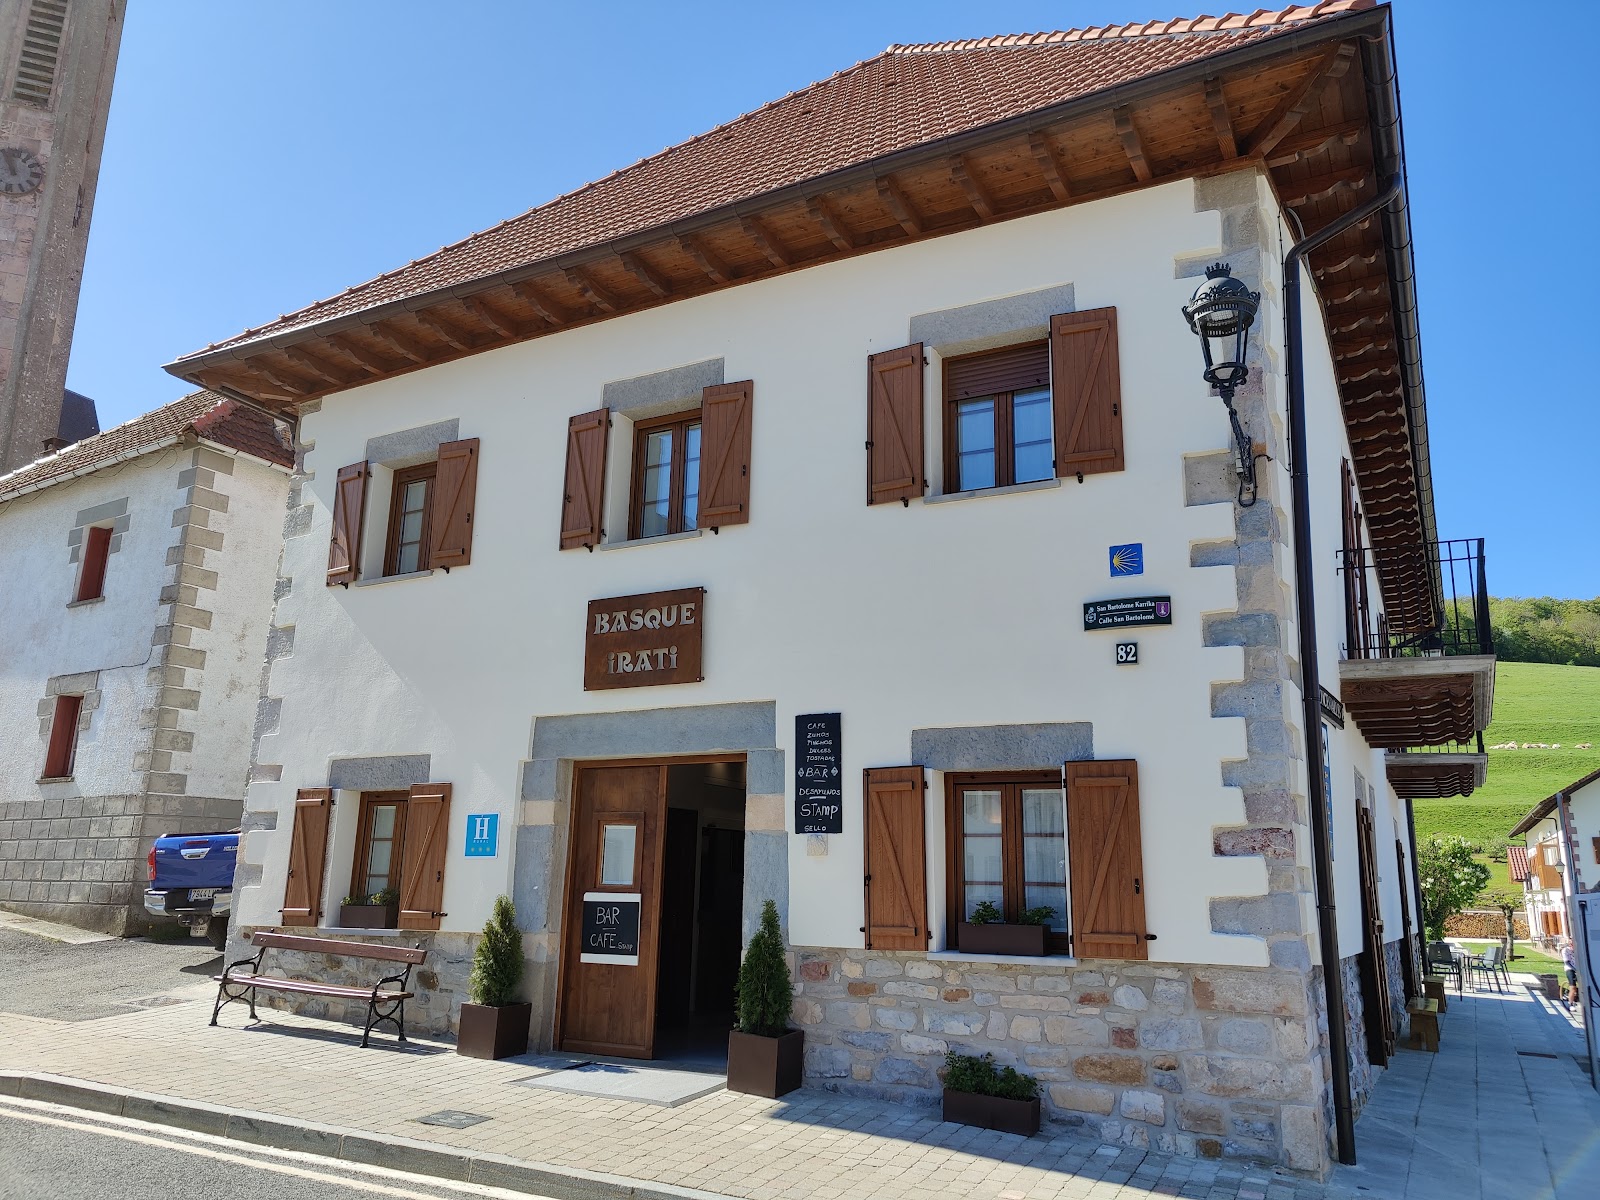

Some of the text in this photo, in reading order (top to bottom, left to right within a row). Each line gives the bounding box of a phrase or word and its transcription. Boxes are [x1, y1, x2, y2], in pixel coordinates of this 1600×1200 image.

[1107, 603, 1134, 611] Bartolome
[594, 603, 695, 634] BASQUE
[1098, 616, 1113, 624] Calle
[1125, 613, 1155, 621] Bartolomé
[1117, 644, 1137, 662] 82
[805, 767, 828, 778] BAR
[473, 817, 491, 840] H
[596, 906, 620, 925] BAR
[590, 933, 617, 949] CAFE
